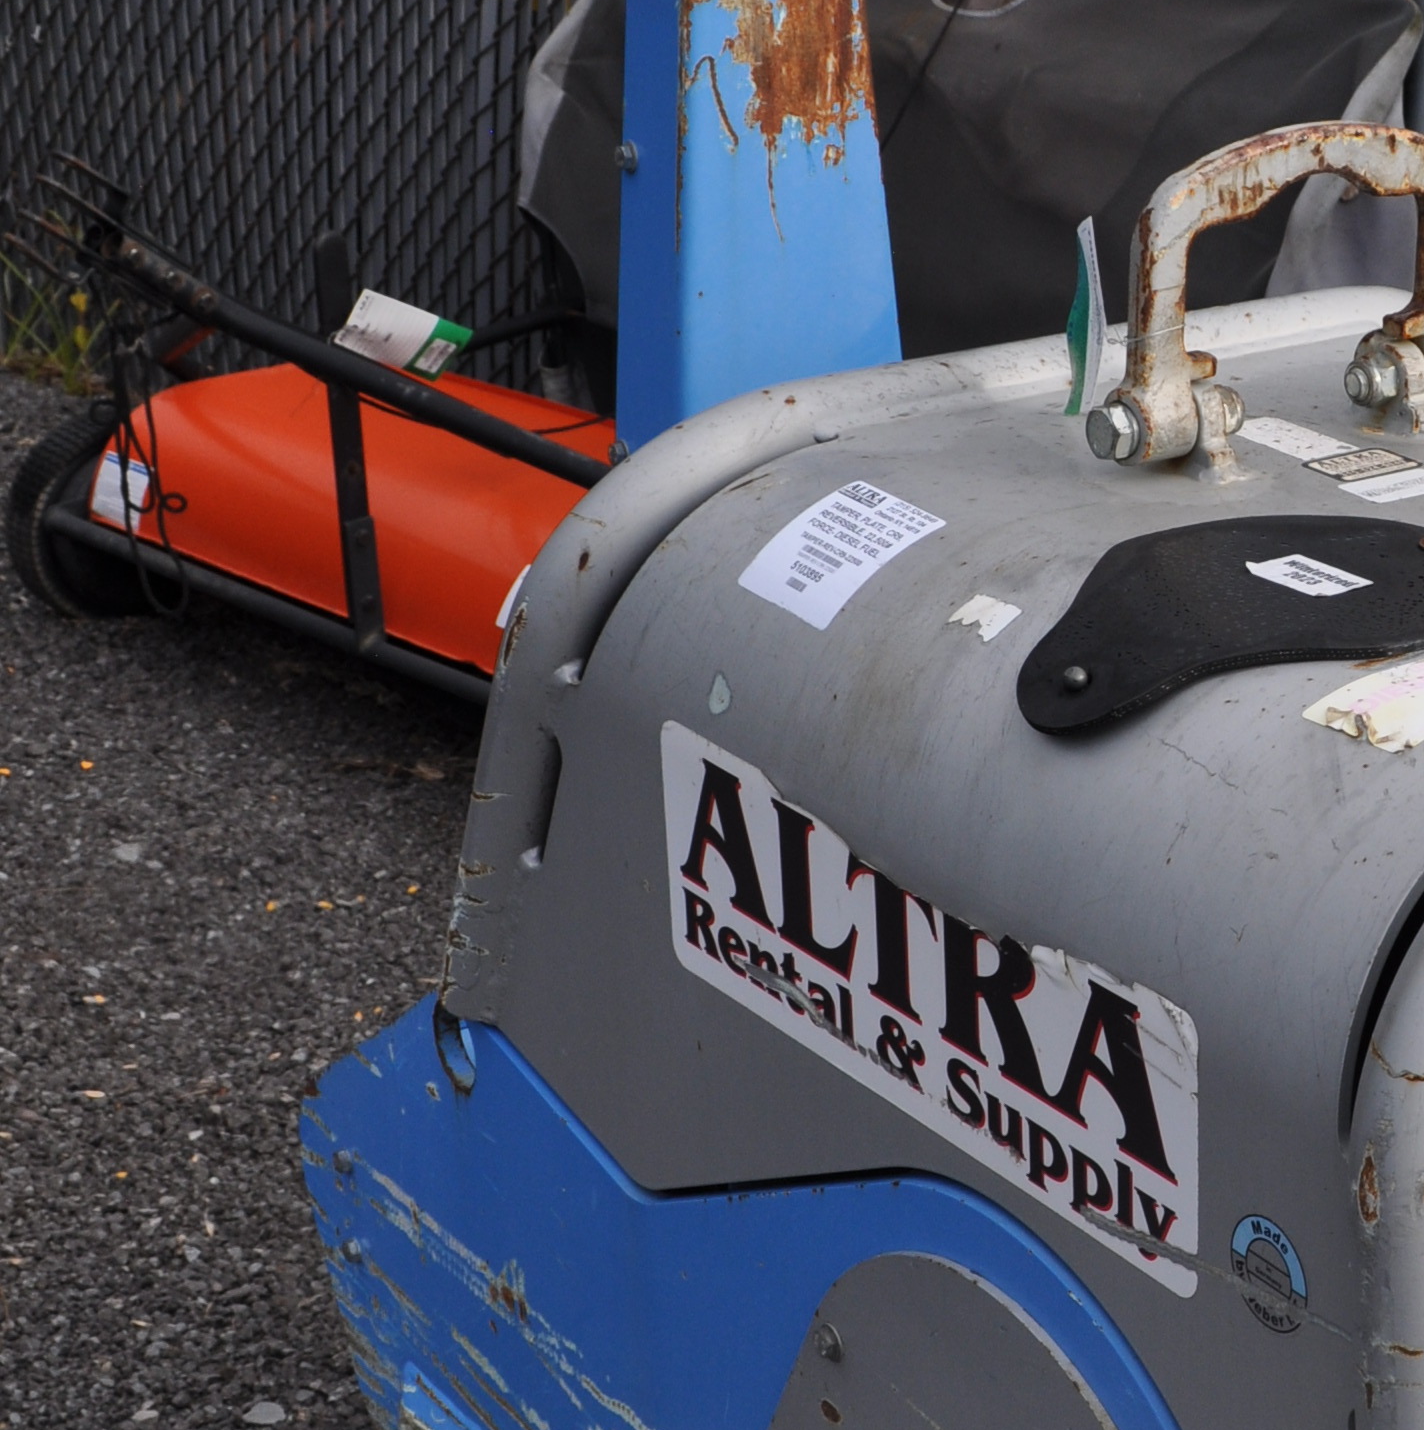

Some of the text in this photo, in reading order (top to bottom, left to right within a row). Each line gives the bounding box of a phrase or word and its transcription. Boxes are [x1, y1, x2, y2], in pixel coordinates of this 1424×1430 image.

[847, 483, 888, 505] ALTRA
[834, 530, 861, 549] DIESEL
[860, 543, 880, 559] FUEL
[790, 560, 824, 583] 5103895
[680, 758, 1179, 1187] ALTRA
[682, 886, 1178, 1262] Rental & Supply
[1250, 1220, 1289, 1255] Made
[1248, 1297, 1284, 1328] eber
